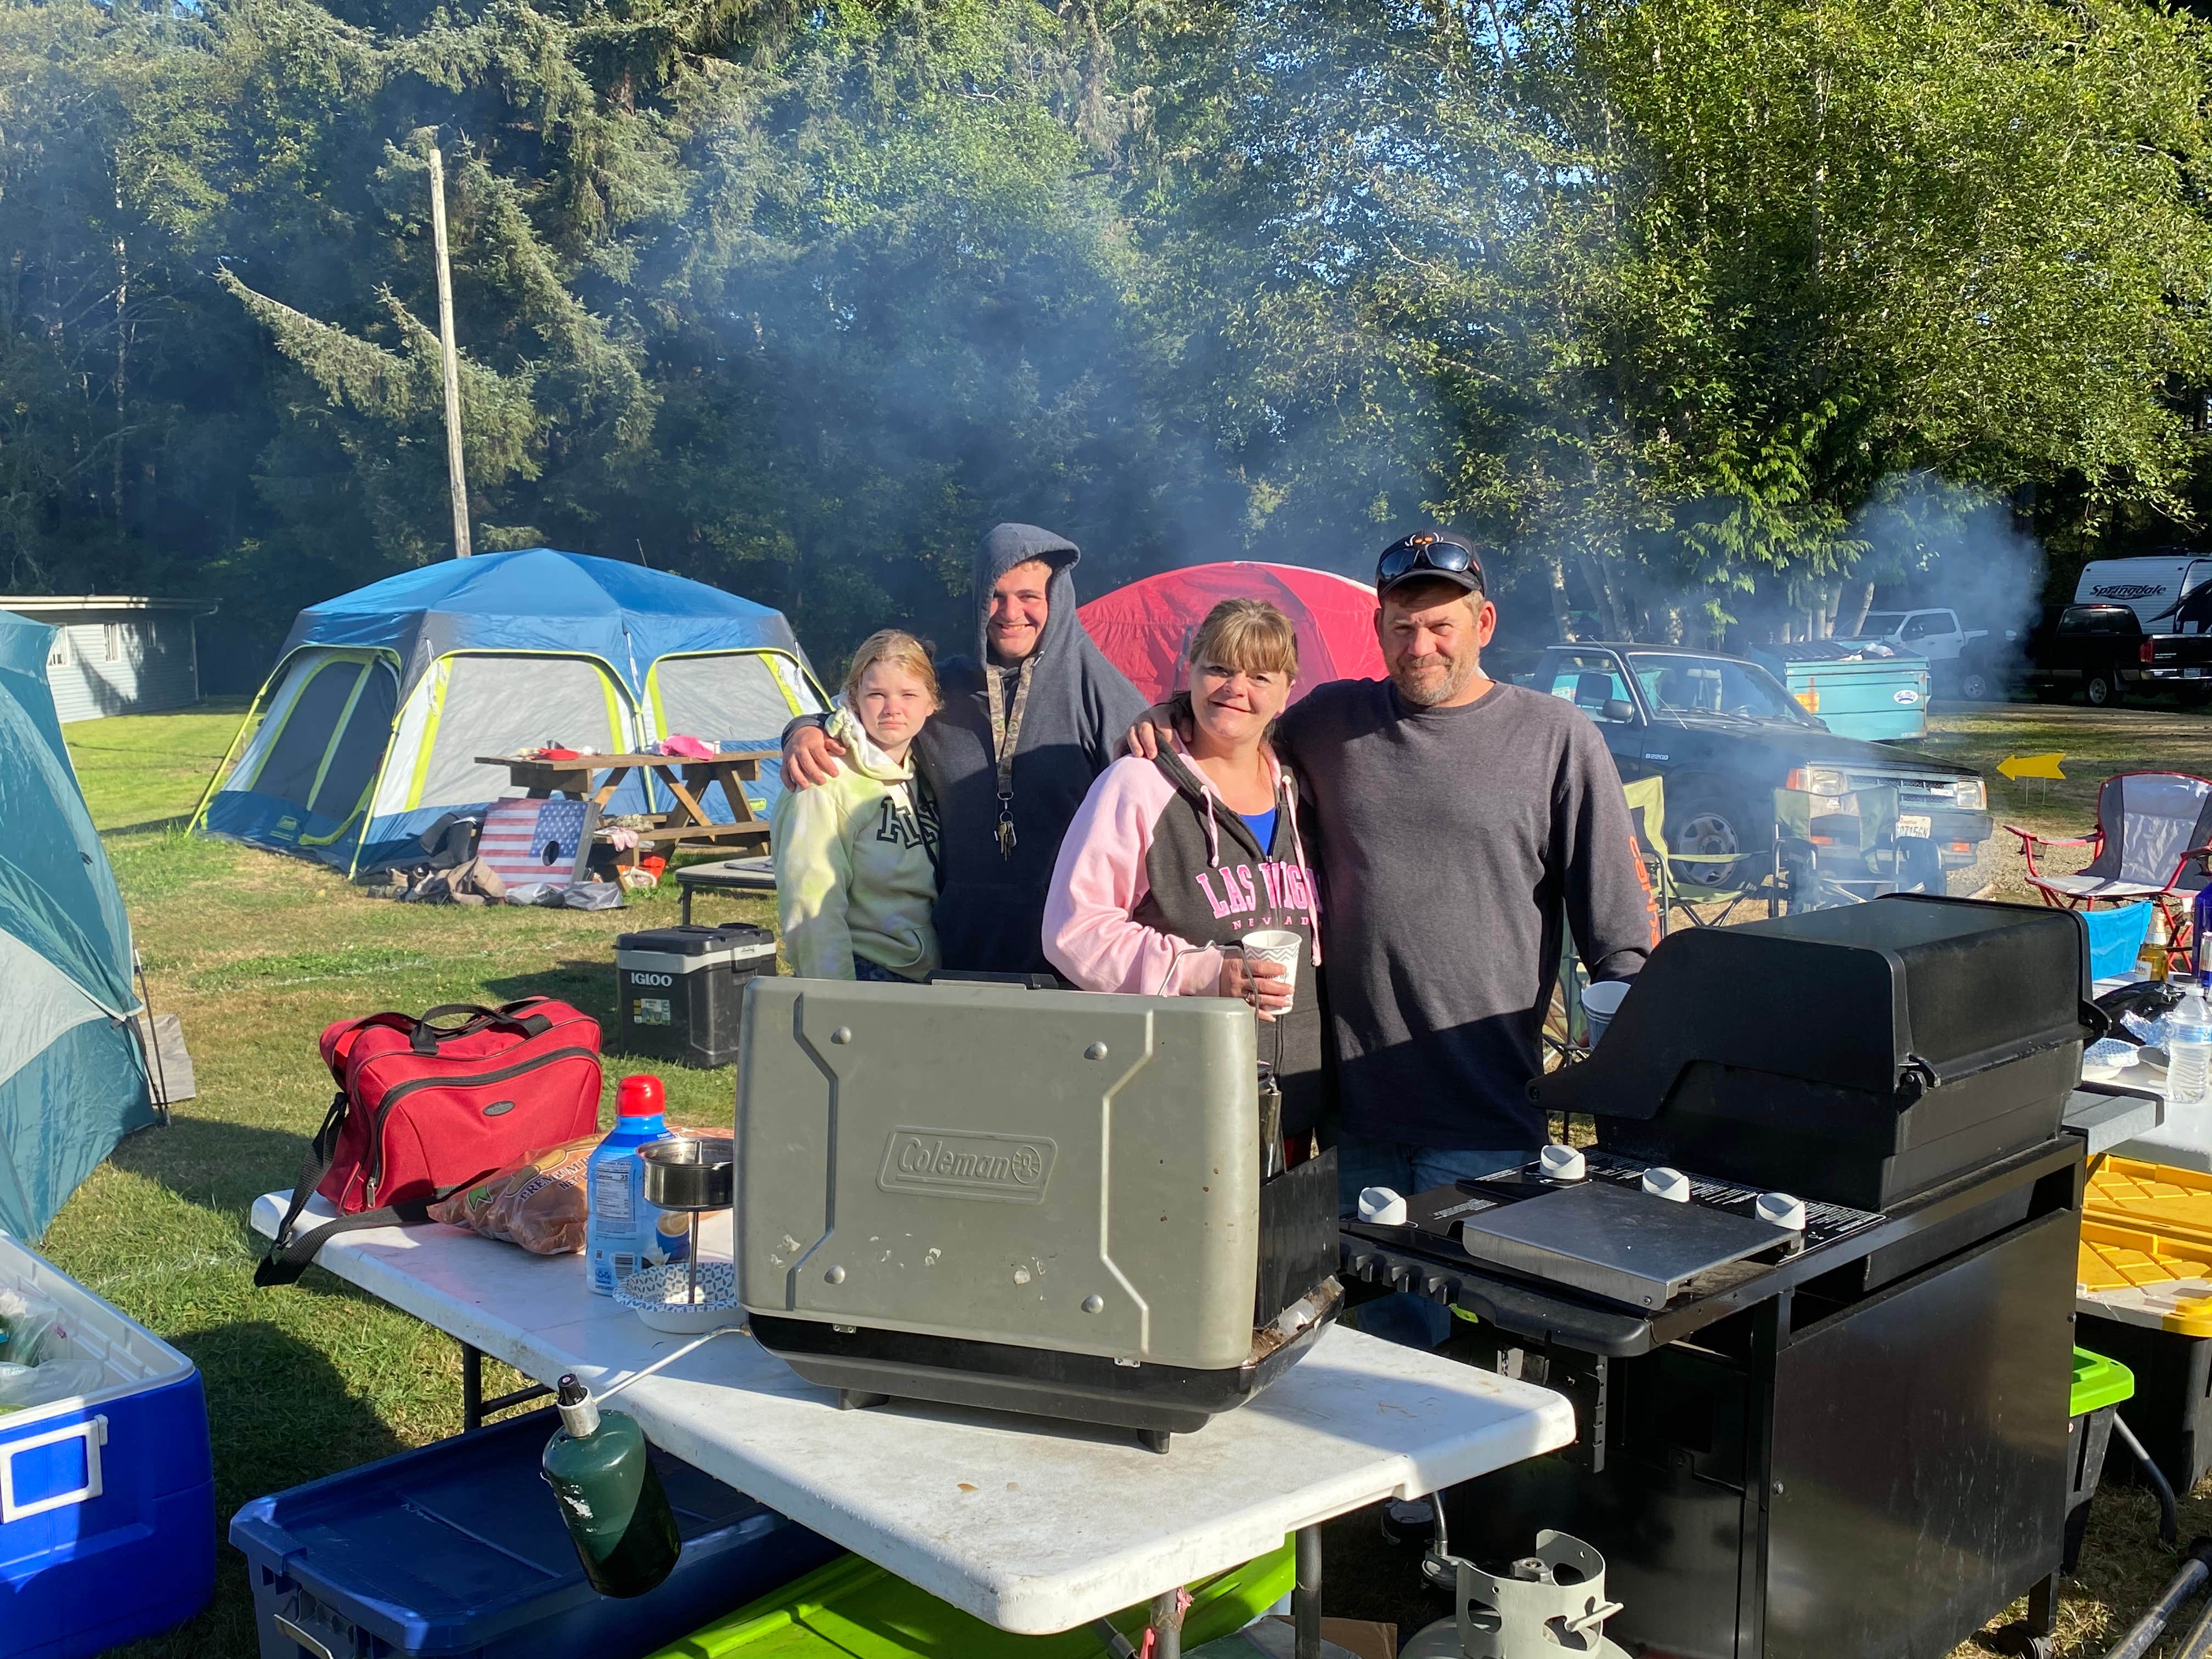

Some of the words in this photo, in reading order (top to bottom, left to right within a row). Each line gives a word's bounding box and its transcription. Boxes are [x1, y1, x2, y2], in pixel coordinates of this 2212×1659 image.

[2090, 585, 2166, 597] Springdale
[1195, 864, 1256, 919] LAS
[1232, 916, 1322, 930] NEVAD
[630, 972, 673, 987] IGLOO
[898, 1137, 1010, 1180] Coleman
